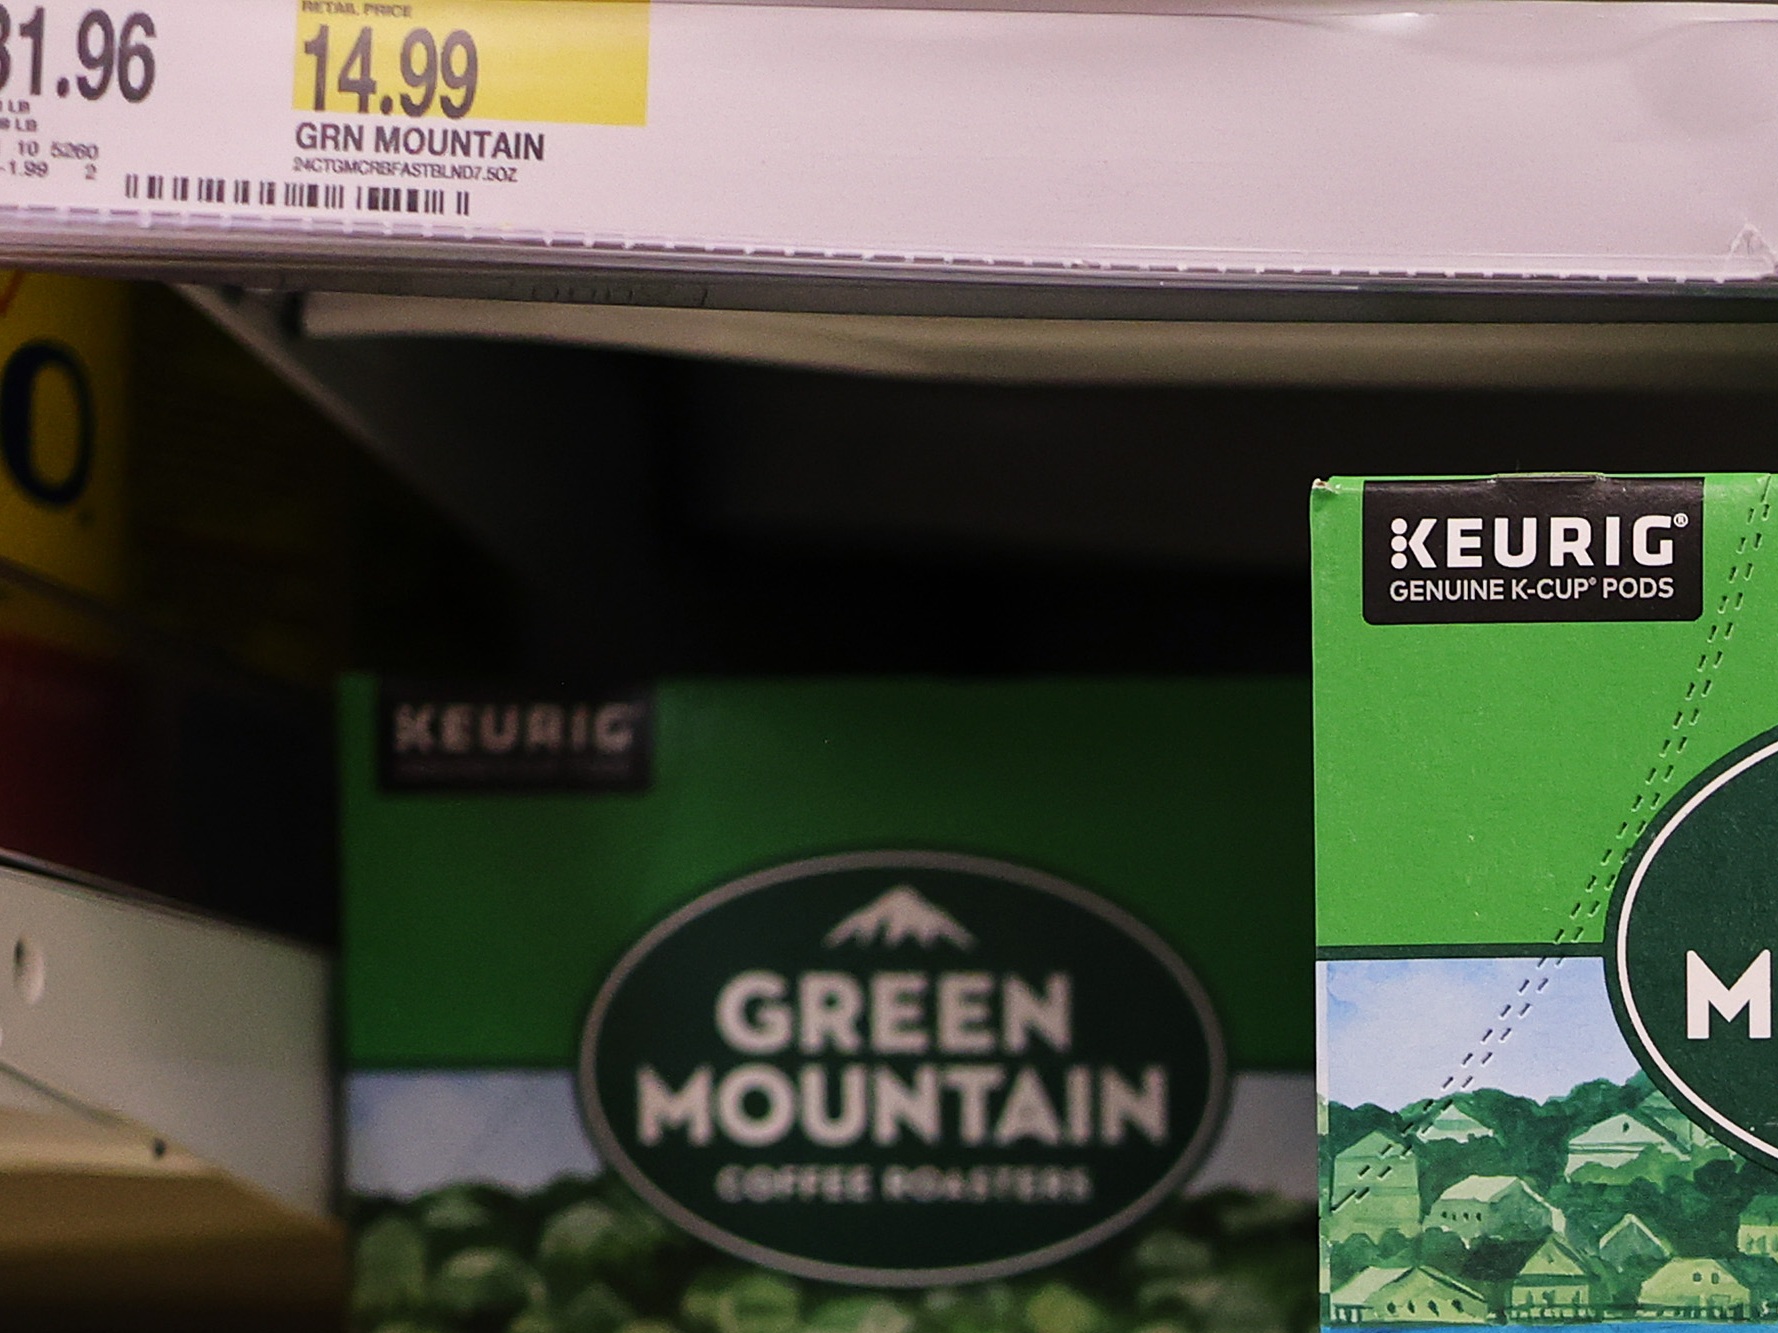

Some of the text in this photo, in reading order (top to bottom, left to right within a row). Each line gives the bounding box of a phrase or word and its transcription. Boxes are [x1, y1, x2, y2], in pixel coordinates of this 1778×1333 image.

[304, 24, 478, 119] 14.99
[295, 122, 545, 161] GRN MOUNTAIN
[1390, 580, 1504, 601] GENUINE
[1603, 578, 1674, 599] PODS
[713, 970, 1073, 1055] GREEN
[633, 1064, 1170, 1148] MOUNTAIN
